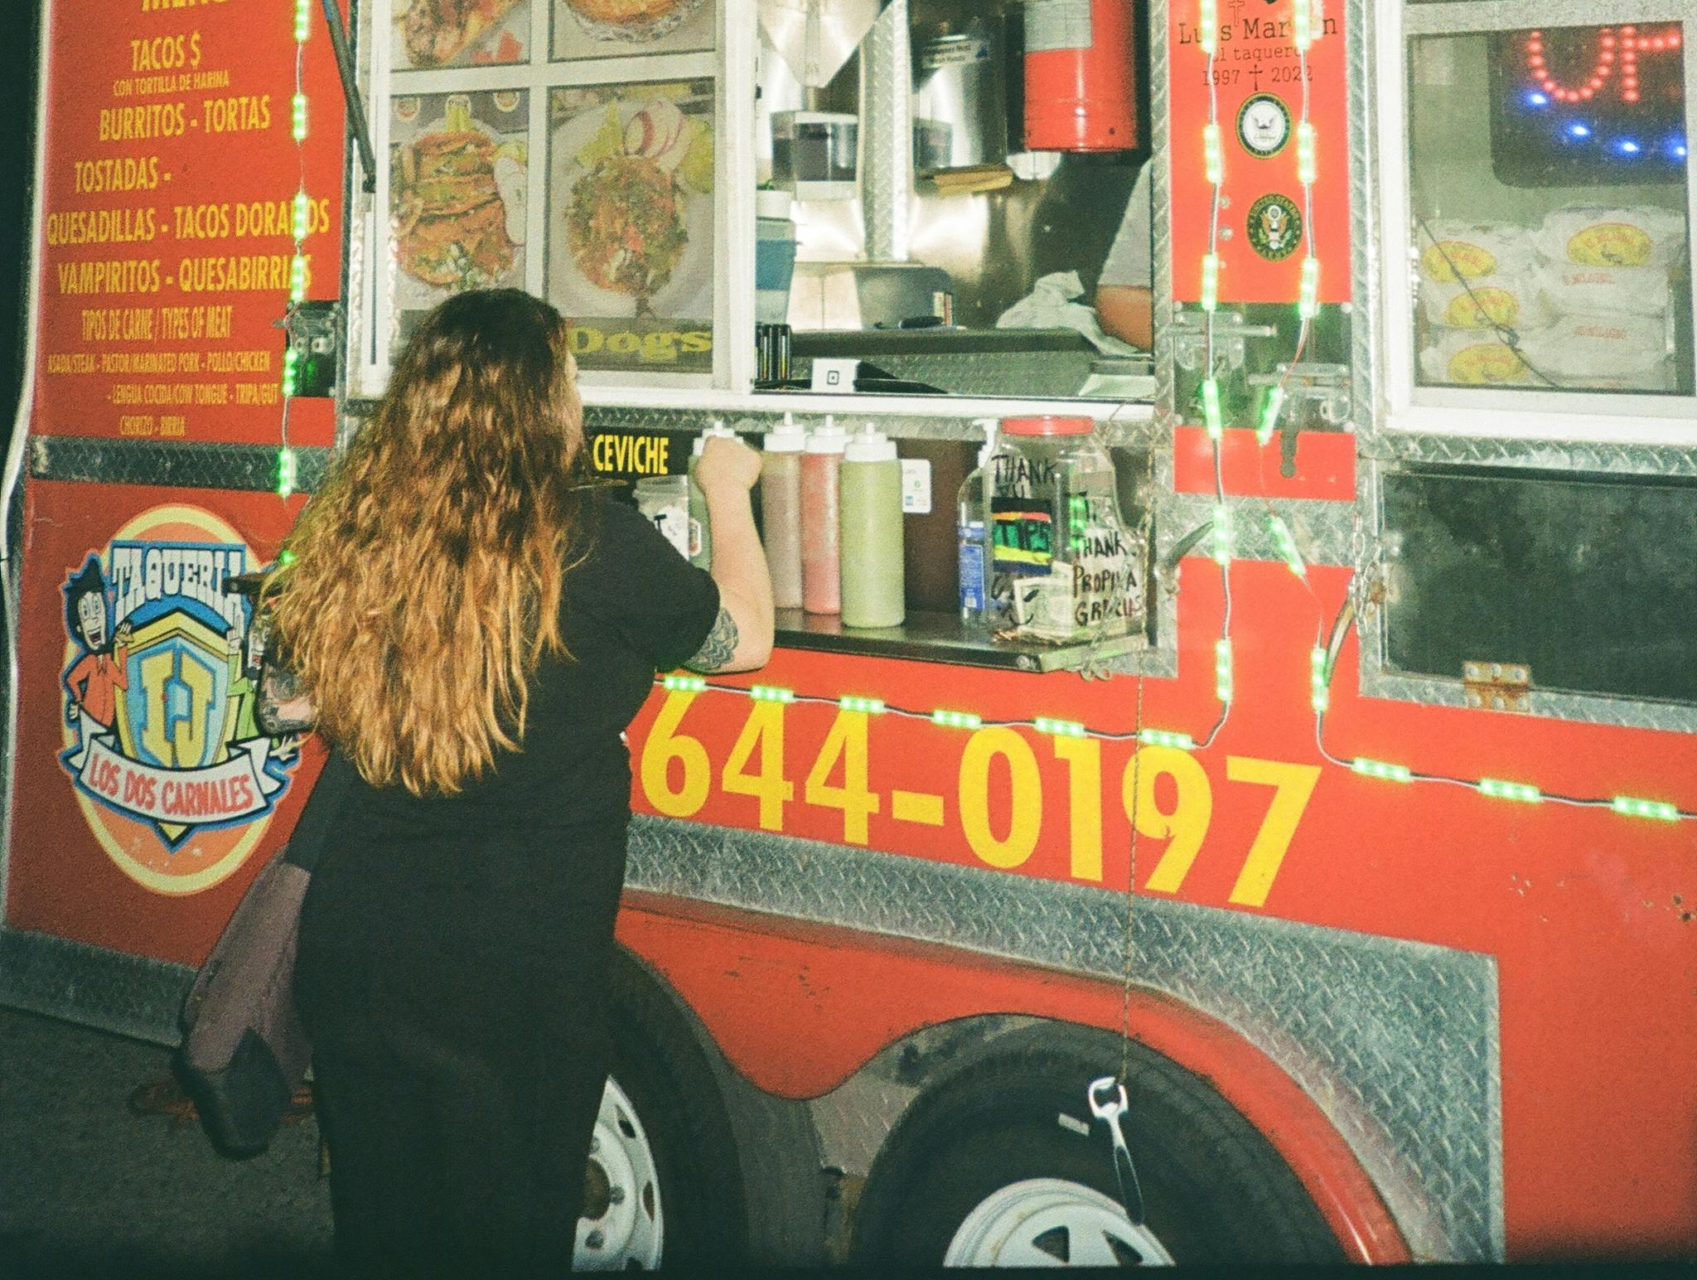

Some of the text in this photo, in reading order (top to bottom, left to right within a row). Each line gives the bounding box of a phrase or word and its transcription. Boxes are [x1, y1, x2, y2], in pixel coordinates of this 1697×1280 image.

[1179, 16, 1338, 45] Lus Marn
[131, 31, 200, 71] TACOS $
[114, 70, 229, 96] CON TORTILLA DE HARINA
[1203, 65, 1313, 86] 1997 2022
[100, 102, 185, 141] BURRITOS
[203, 95, 271, 133] TORTAS
[75, 156, 159, 193] TOSTADAS
[47, 208, 156, 245] QUESADILLAS
[174, 204, 230, 239] TACOS
[236, 199, 330, 238] DORAOS
[58, 259, 161, 294] VAMPIRITOS
[179, 254, 312, 293] QUESABIRRIS
[82, 309, 107, 341] TIPOS
[109, 308, 121, 340] DE
[123, 307, 152, 340] CARNE
[161, 306, 189, 339] TYPES
[192, 306, 204, 338] OF
[206, 305, 233, 338] MEAT
[568, 327, 713, 363] Dogs
[593, 434, 669, 475] CEVICHE
[992, 455, 1058, 486] THANK
[89, 753, 254, 816] LOS DOS CARNALES
[640, 688, 1322, 908] 644-0197
